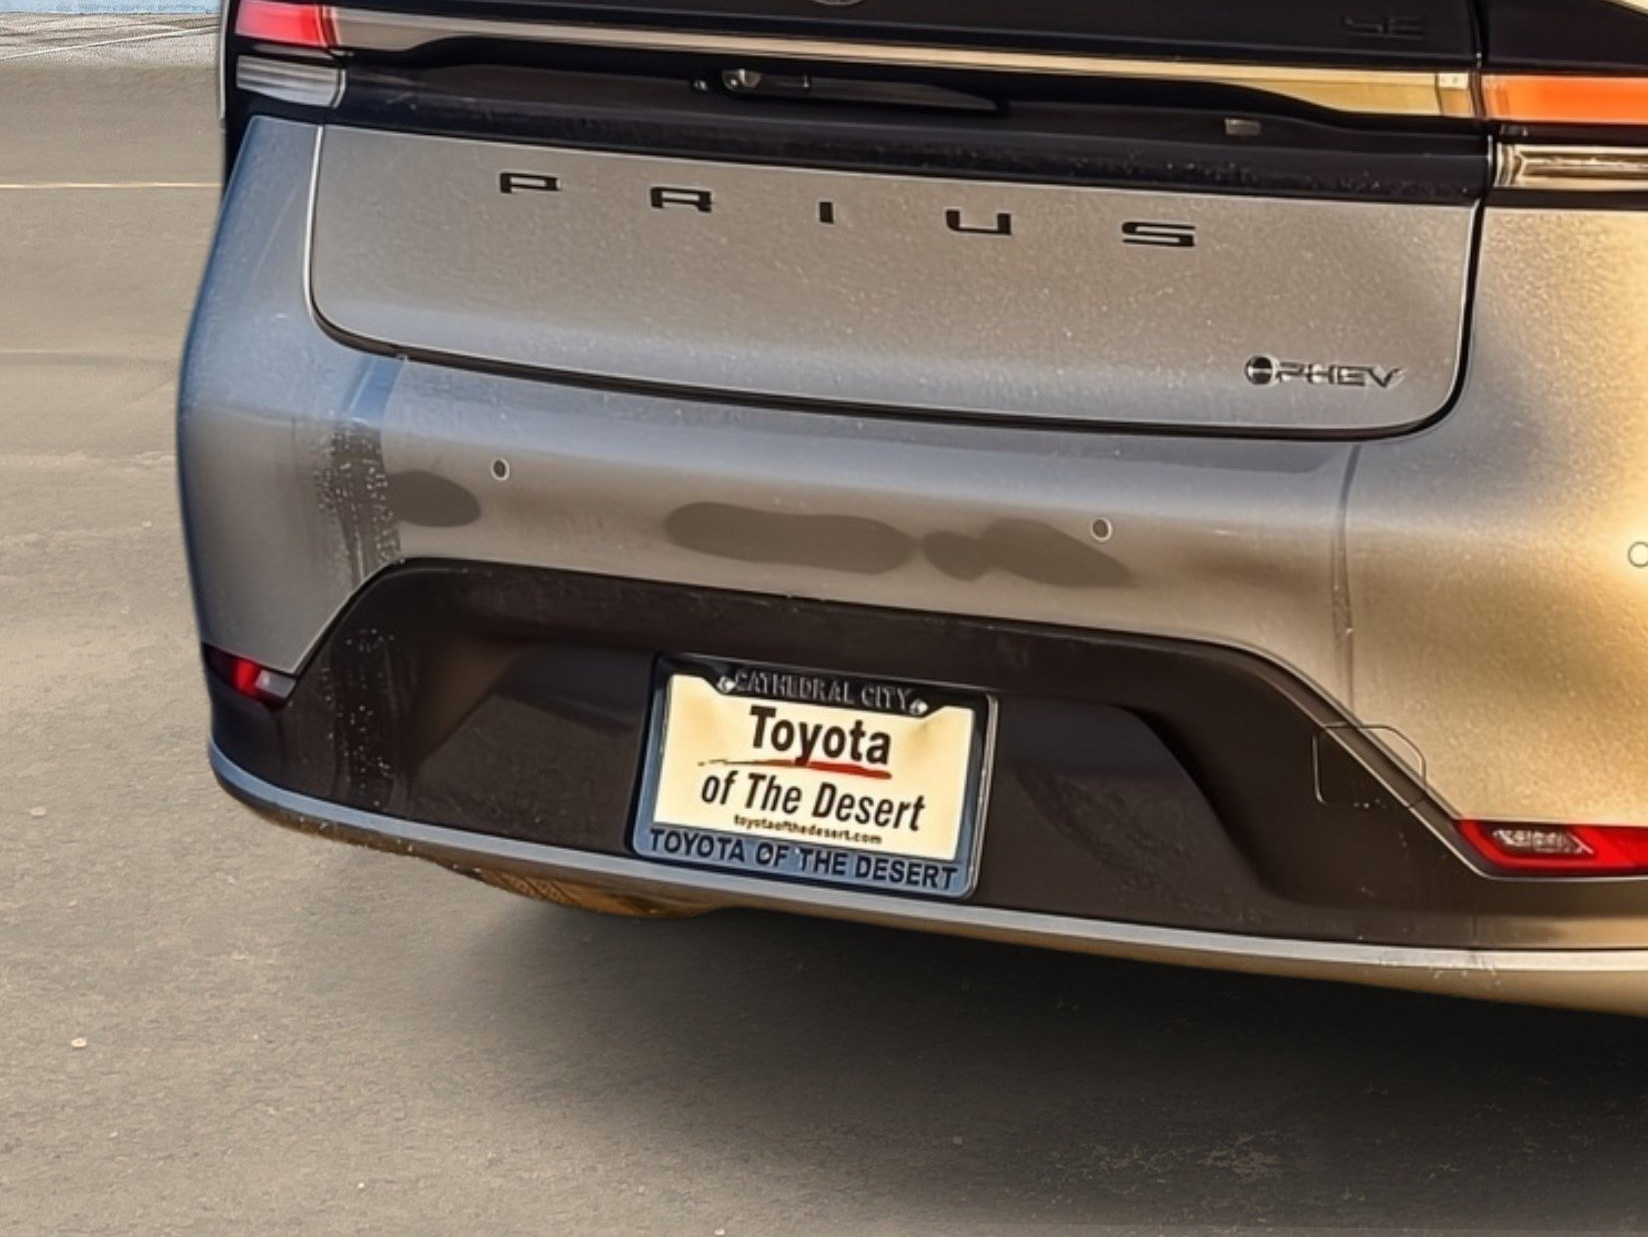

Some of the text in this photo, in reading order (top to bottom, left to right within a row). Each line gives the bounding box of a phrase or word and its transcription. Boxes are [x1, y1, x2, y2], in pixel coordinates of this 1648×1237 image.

[499, 170, 1197, 248] PRIUS
[1276, 361, 1403, 389] PHEV
[734, 669, 913, 711] CATHEDRAL CITY
[749, 704, 892, 766] Toyota
[701, 769, 927, 832] of The Desert
[733, 814, 883, 844] toyotaofthedesert.com
[650, 827, 958, 891] TOYOTA OF THE DESERT
